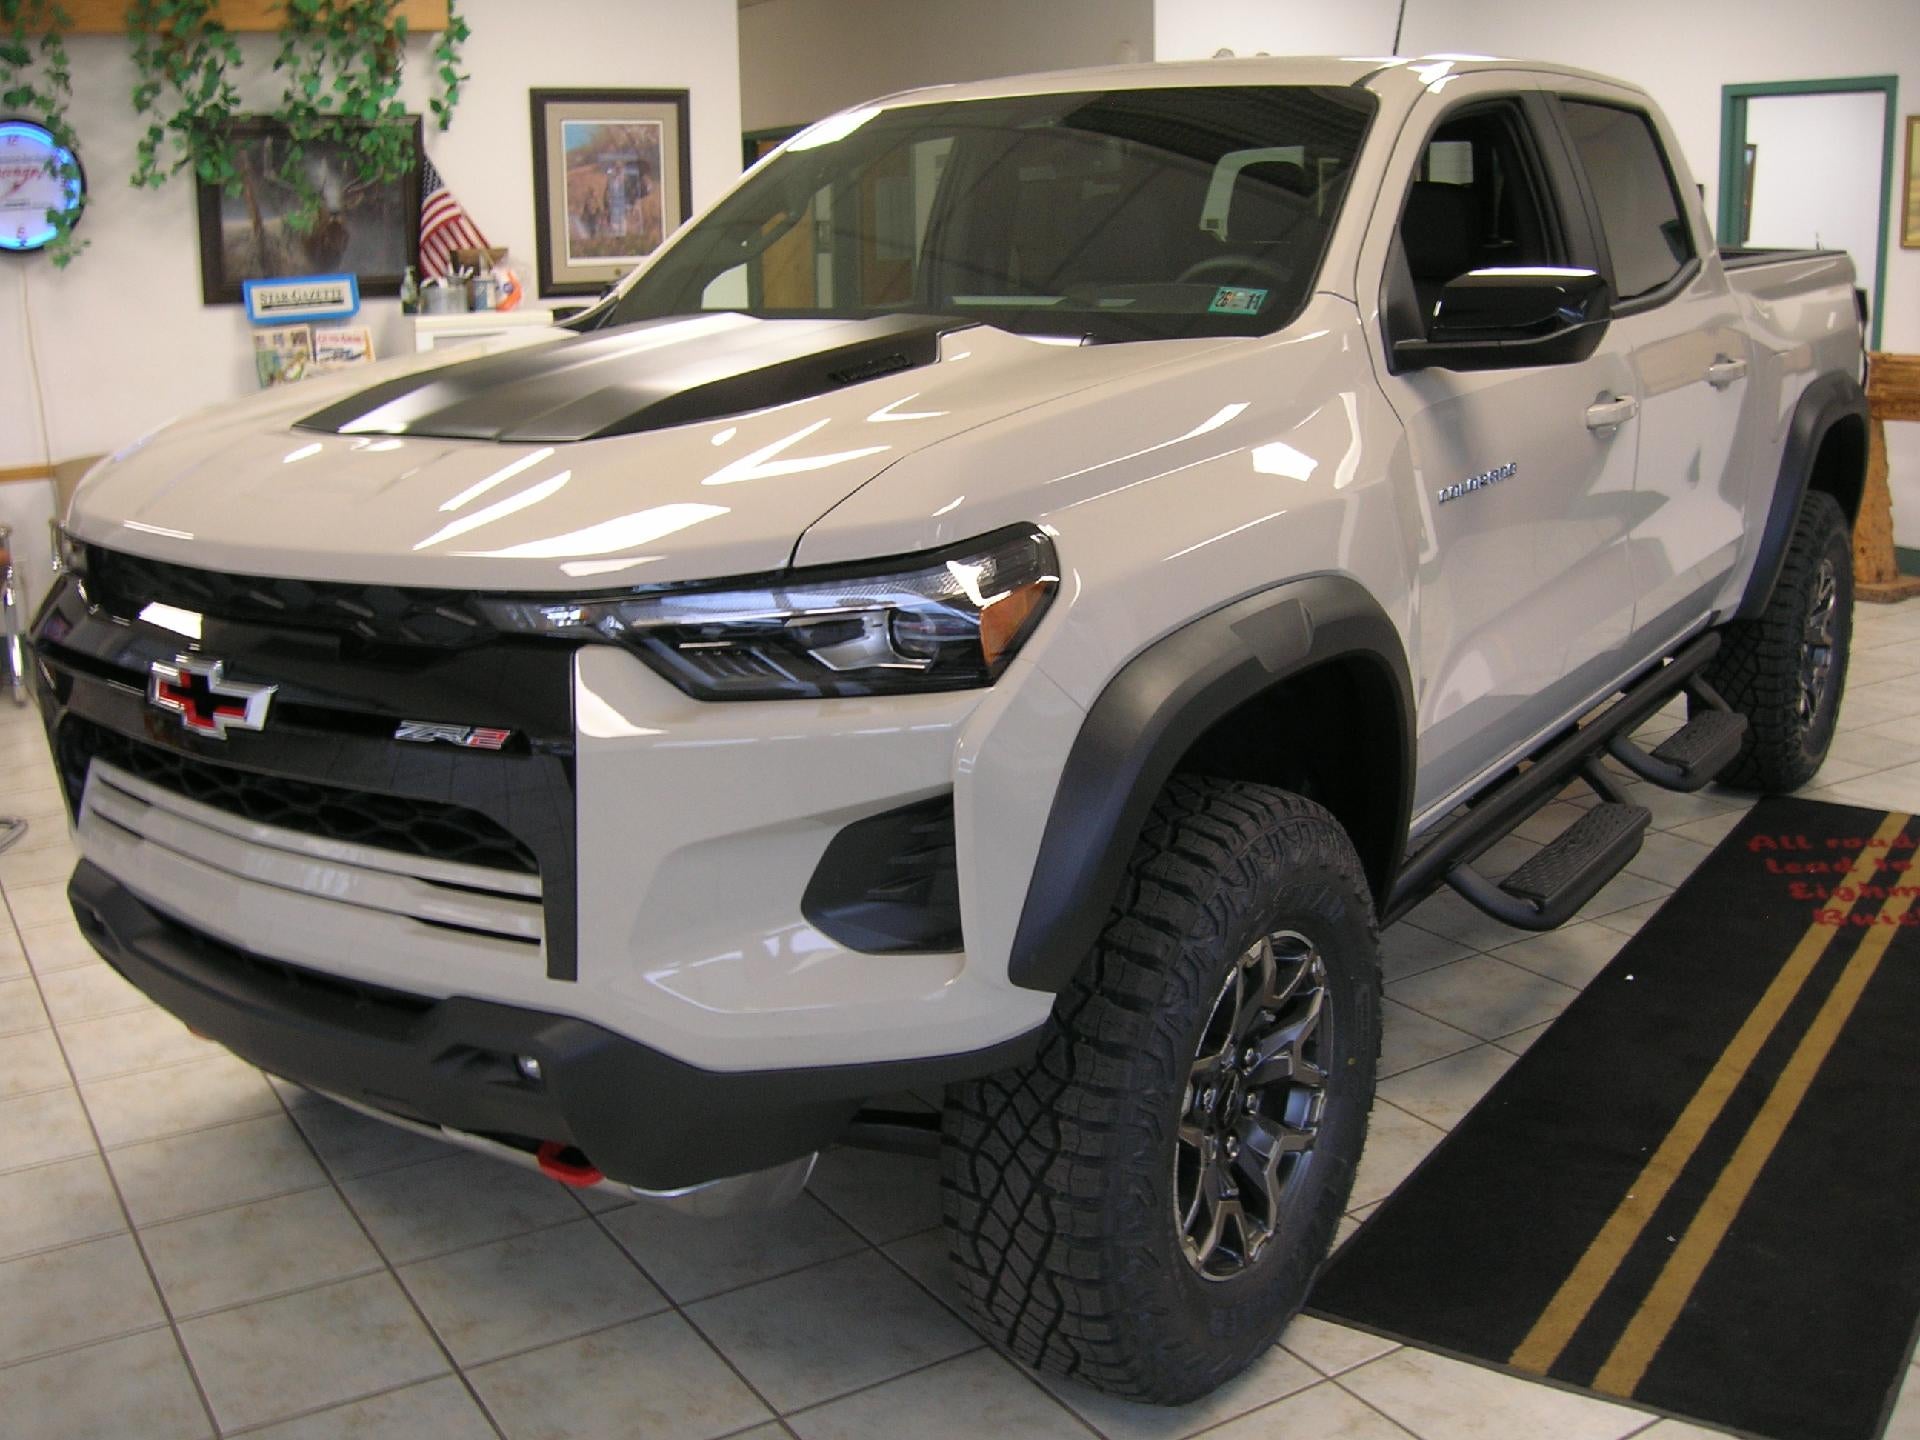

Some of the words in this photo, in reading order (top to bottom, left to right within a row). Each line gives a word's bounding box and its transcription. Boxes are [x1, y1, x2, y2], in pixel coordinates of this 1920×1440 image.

[1747, 834, 1813, 852] All
[1825, 833, 1920, 849] road
[1873, 858, 1912, 872] to
